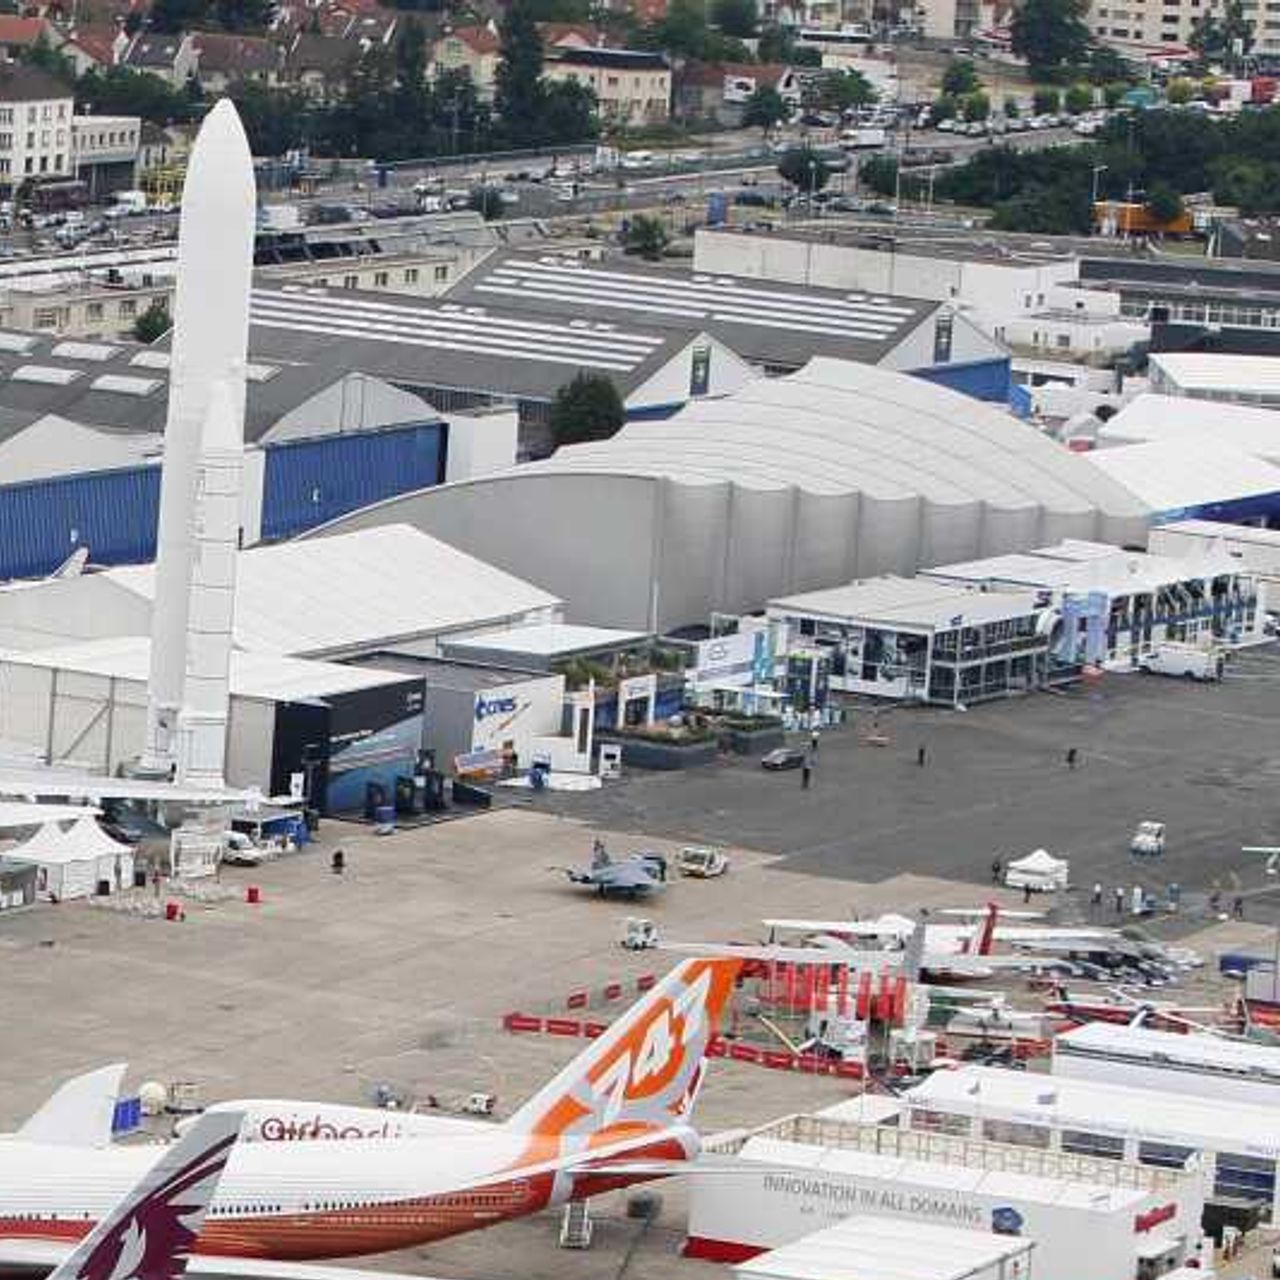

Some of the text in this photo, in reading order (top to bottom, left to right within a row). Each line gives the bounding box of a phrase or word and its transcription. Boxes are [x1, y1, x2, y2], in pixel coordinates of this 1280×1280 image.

[762, 1175, 982, 1223] INNOVATION IN ALL DOMAINS
